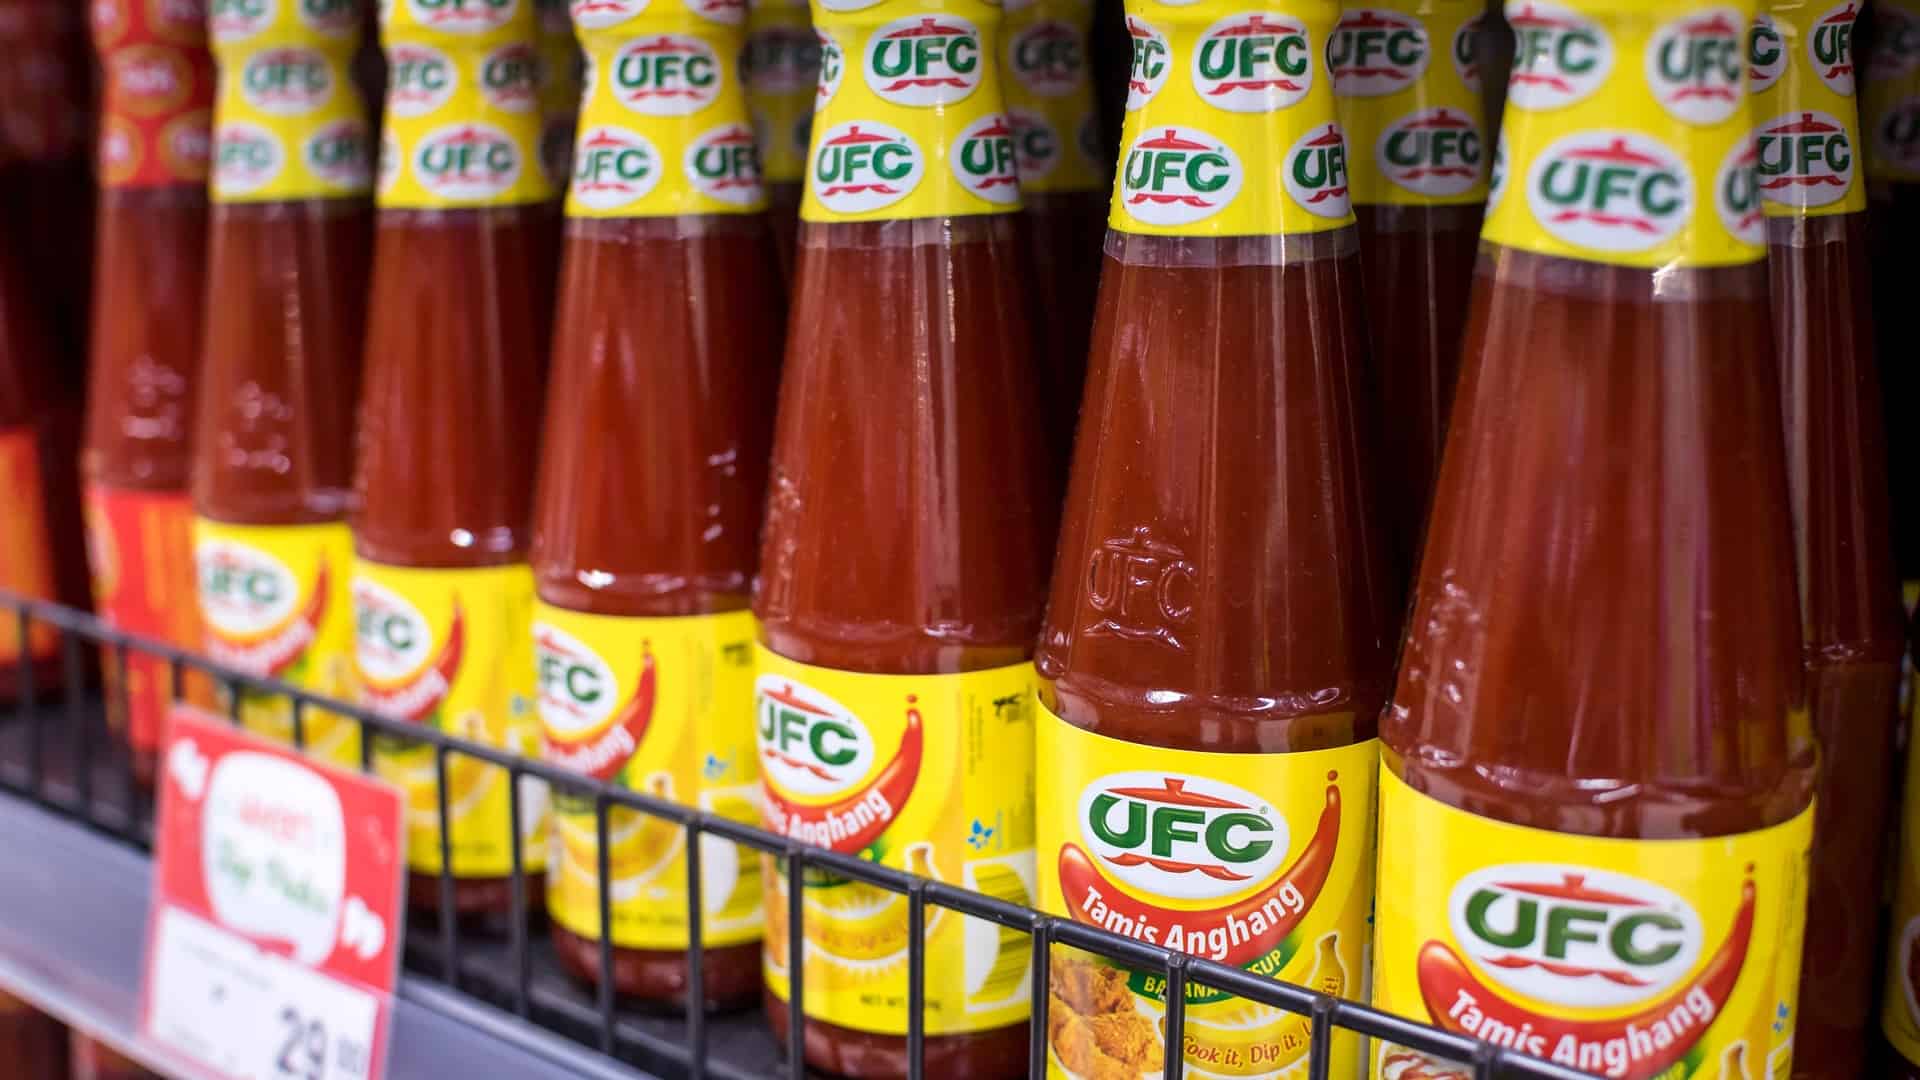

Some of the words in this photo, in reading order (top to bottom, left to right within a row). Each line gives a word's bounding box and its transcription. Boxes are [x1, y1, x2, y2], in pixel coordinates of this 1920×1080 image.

[872, 36, 977, 78] UFC
[1132, 38, 1166, 80] FC
[1198, 36, 1307, 80] UFC
[1659, 37, 1742, 82] UFC
[1813, 22, 1854, 65] UF
[618, 56, 715, 88] UFC
[420, 144, 514, 174] UFC
[816, 143, 913, 184] UFC
[960, 138, 1014, 176] UF
[1292, 147, 1346, 189] UF
[1384, 130, 1481, 167] UFC
[1759, 134, 1851, 176] UFC
[1125, 152, 1230, 193] UFC
[1539, 160, 1680, 216] UFC
[1087, 549, 1197, 623] UFC
[543, 655, 602, 703] FC
[1088, 793, 1274, 864] UFC
[1080, 885, 1159, 946] Tamis
[1163, 880, 1305, 961] Anghang
[1465, 889, 1685, 967] UFC
[1448, 988, 1548, 1056] Tamis
[1550, 984, 1716, 1079] Anghang
[1224, 1051, 1244, 1068] it,
[1250, 1039, 1280, 1065] Dip
